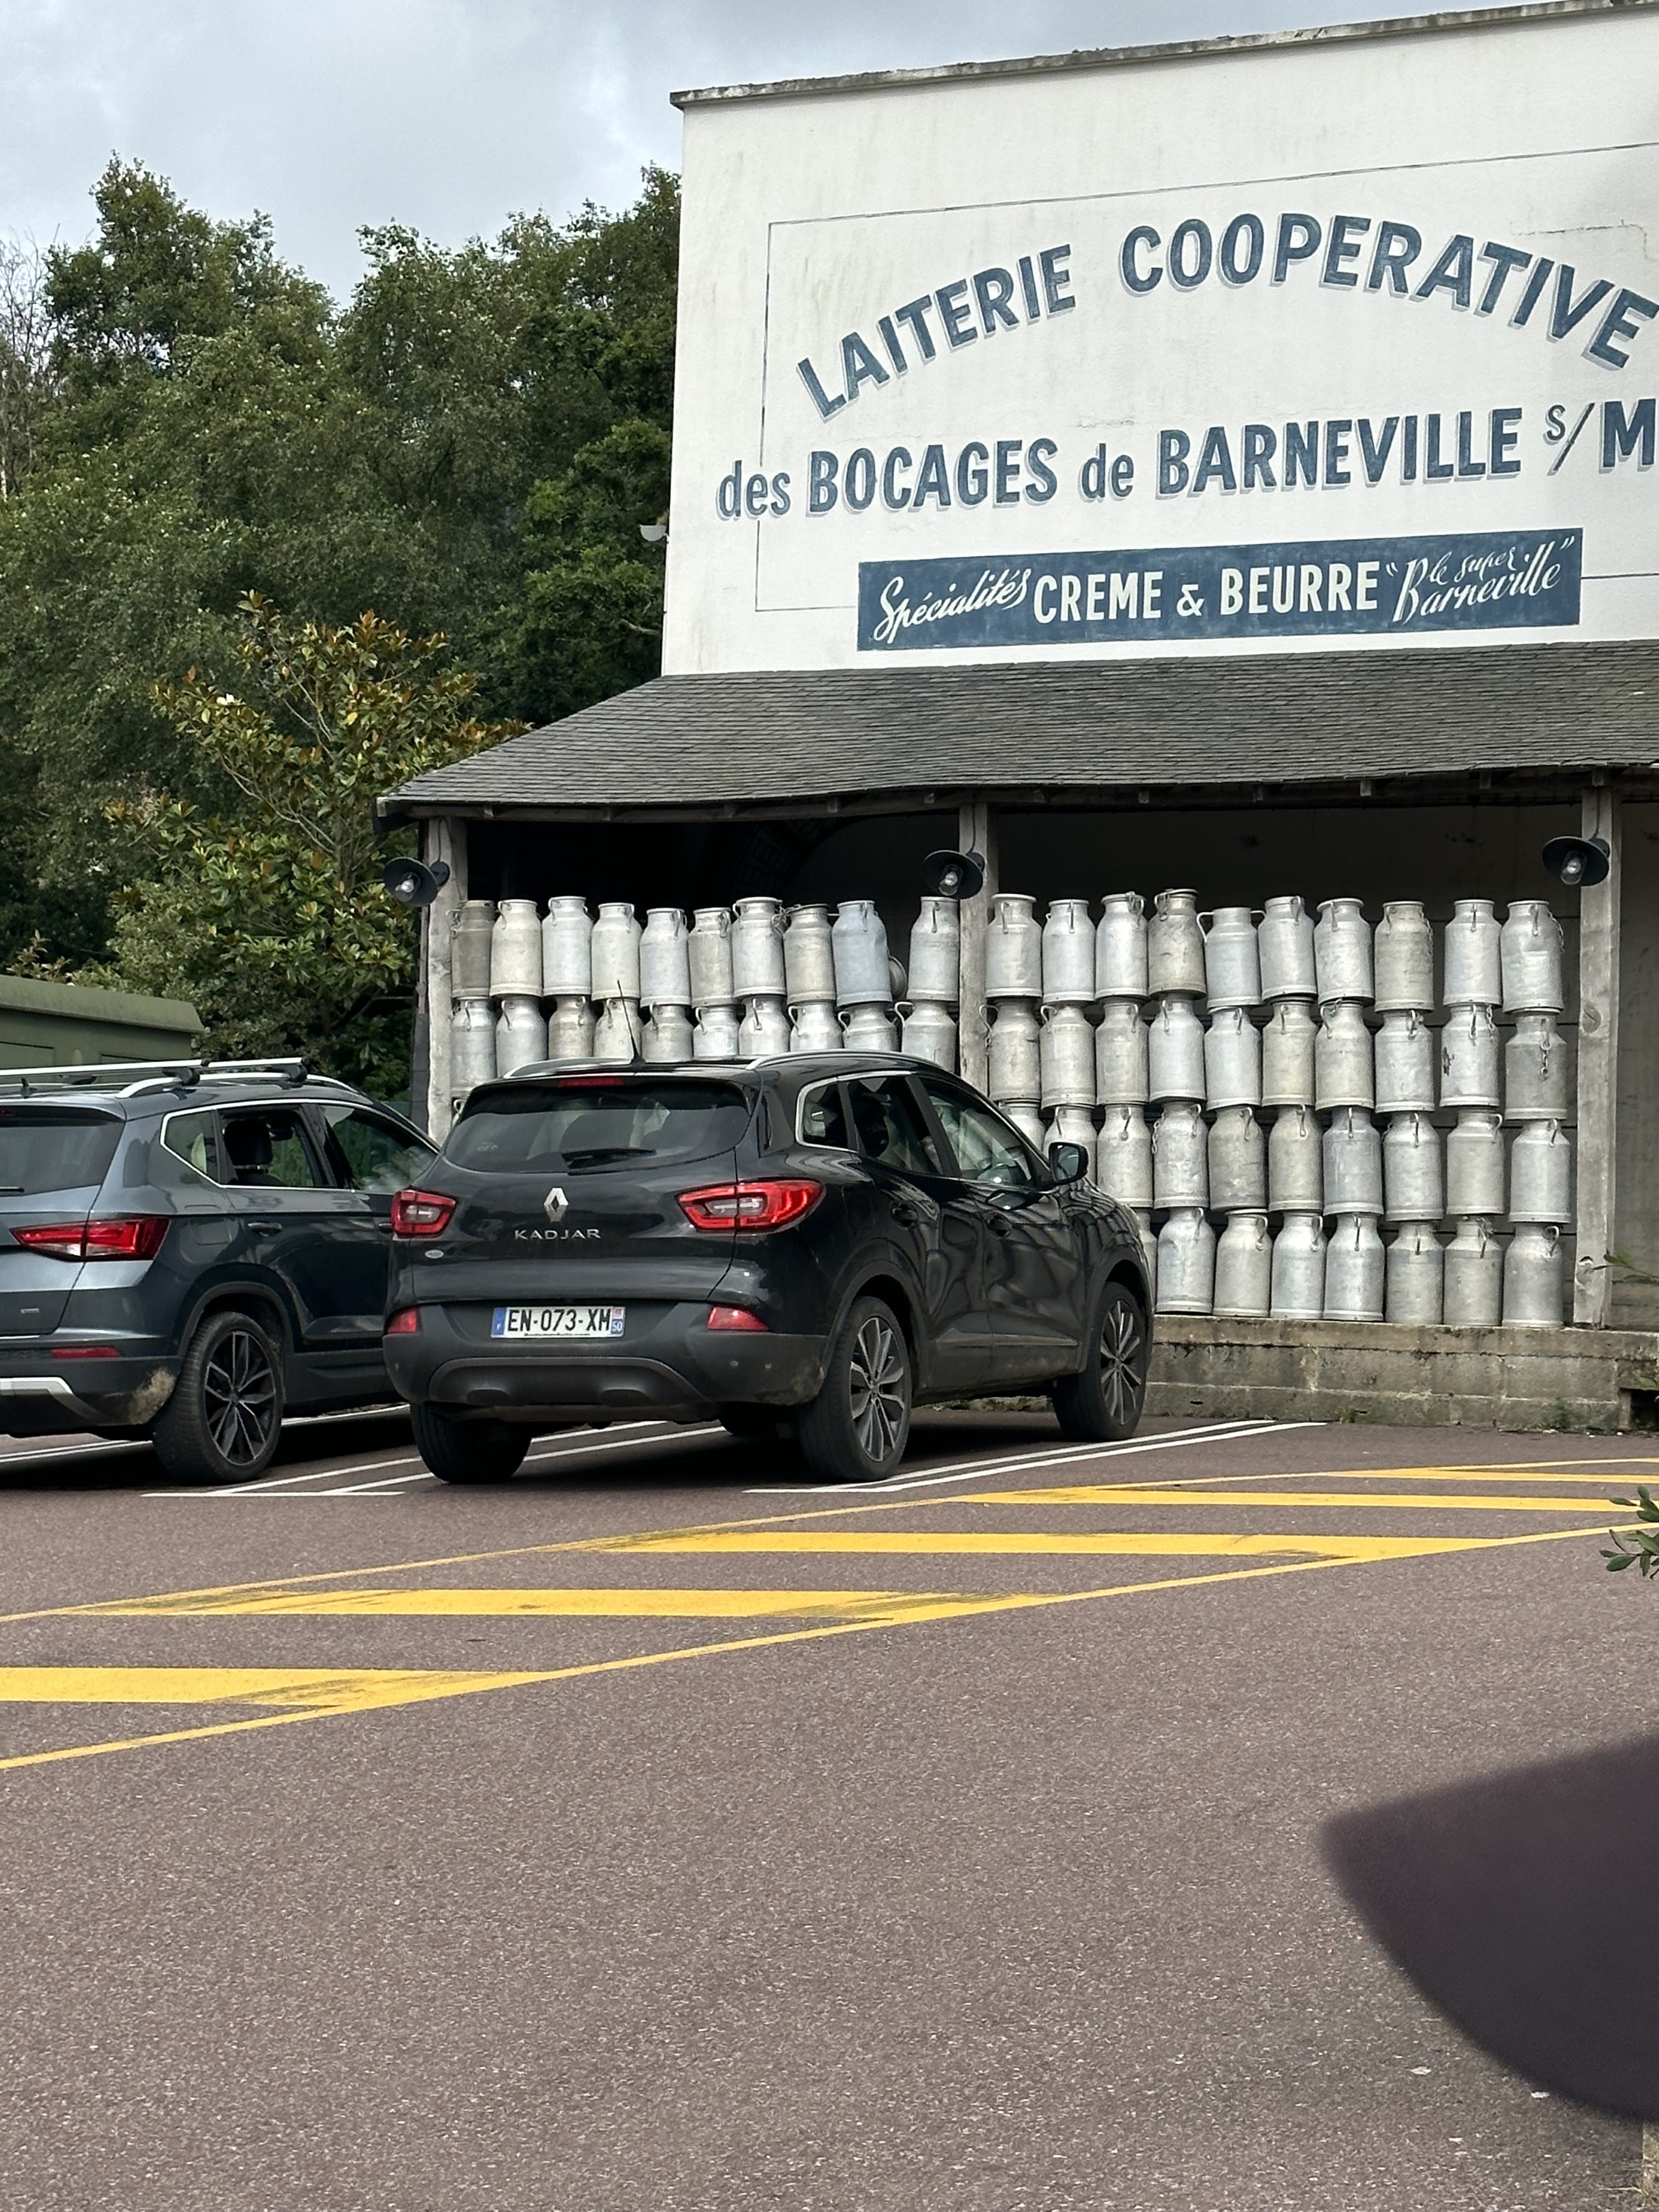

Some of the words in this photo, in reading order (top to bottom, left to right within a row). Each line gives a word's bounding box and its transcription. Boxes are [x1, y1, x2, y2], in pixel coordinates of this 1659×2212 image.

[798, 244, 1076, 419] LAITERIE
[1120, 212, 1659, 369] COOPERATIVE
[718, 460, 790, 518] des
[809, 438, 1058, 514] BOCAGES
[1080, 443, 1133, 500] de
[1158, 408, 1522, 497] BARNEVILLE
[1429, 551, 1452, 585] le
[1454, 546, 1516, 583] super
[873, 568, 1031, 644] Spécialités
[1034, 571, 1163, 624] CREME
[1176, 584, 1204, 617] &
[1220, 561, 1380, 615] BEURRE
[515, 1228, 601, 1240] KADJAR
[612, 1321, 623, 1332] 50
